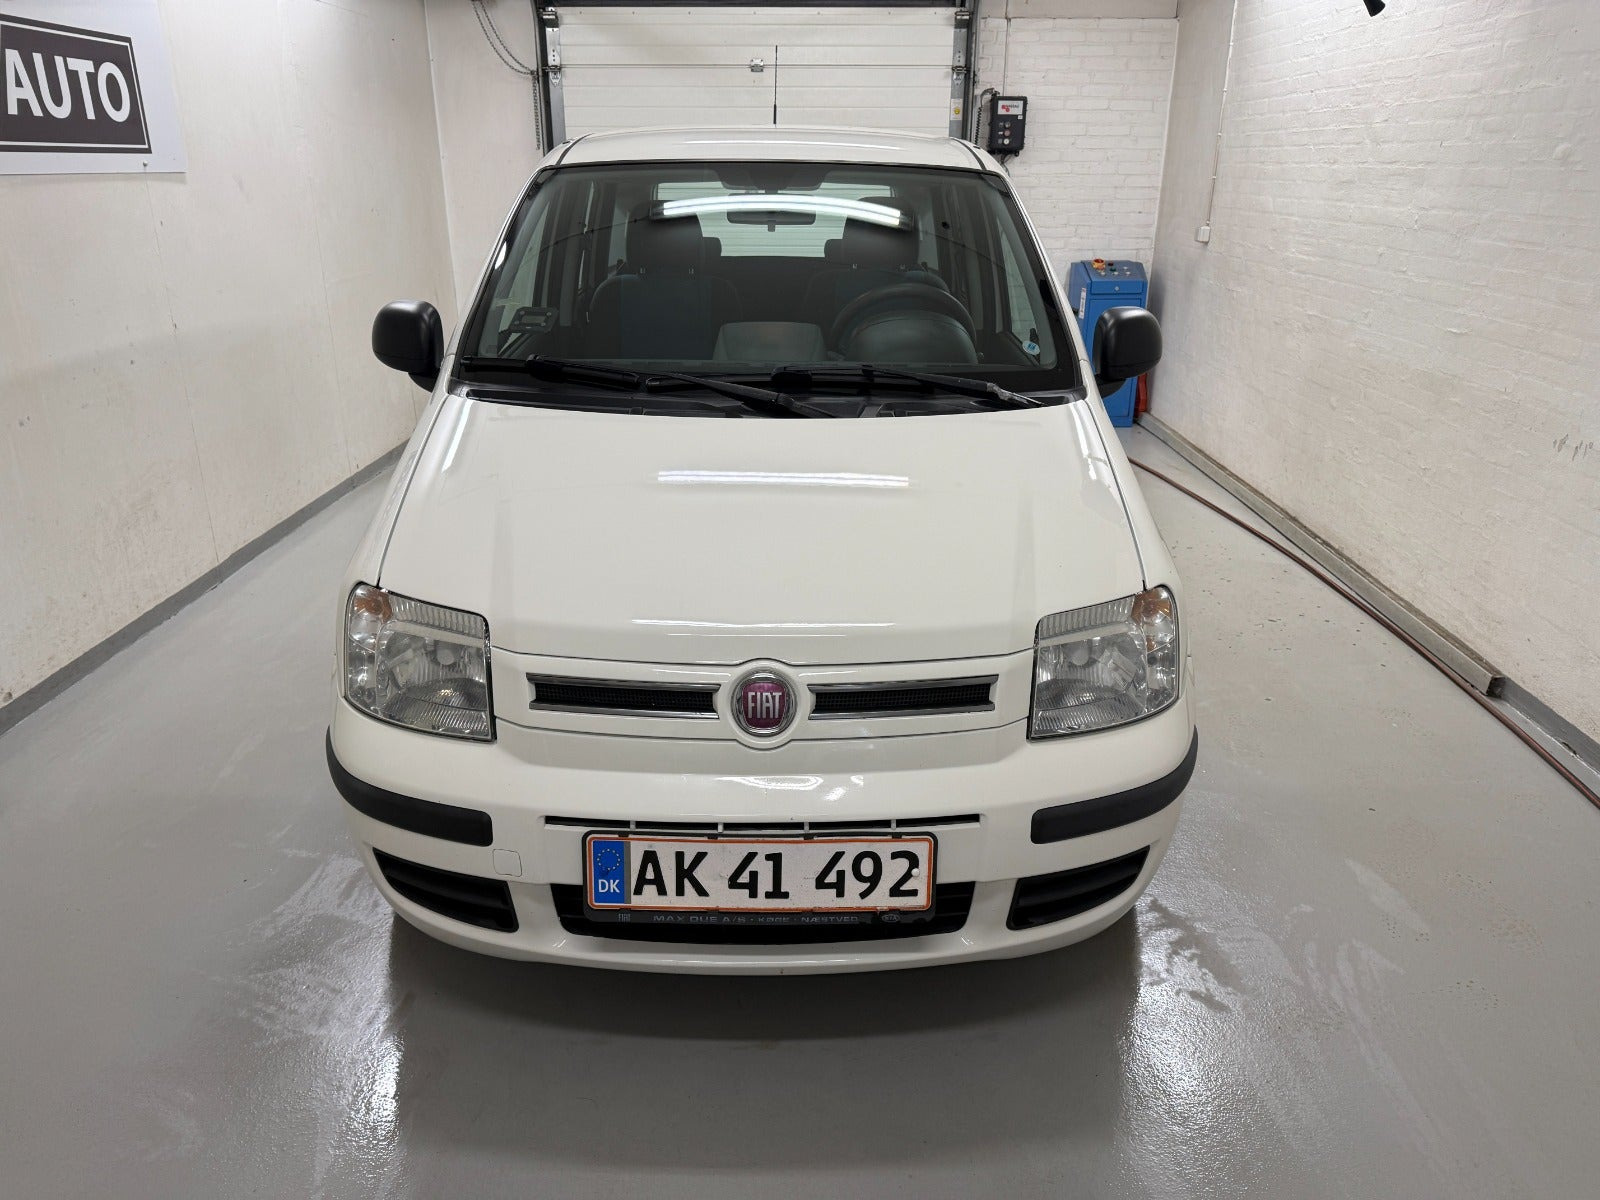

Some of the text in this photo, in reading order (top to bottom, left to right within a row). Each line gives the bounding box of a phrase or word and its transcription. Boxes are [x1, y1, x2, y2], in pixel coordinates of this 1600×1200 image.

[5, 48, 131, 123] AUTO
[747, 691, 782, 719] FIAT
[597, 878, 620, 894] DK
[632, 849, 920, 900] AK 41 492
[652, 915, 685, 923] MAX
